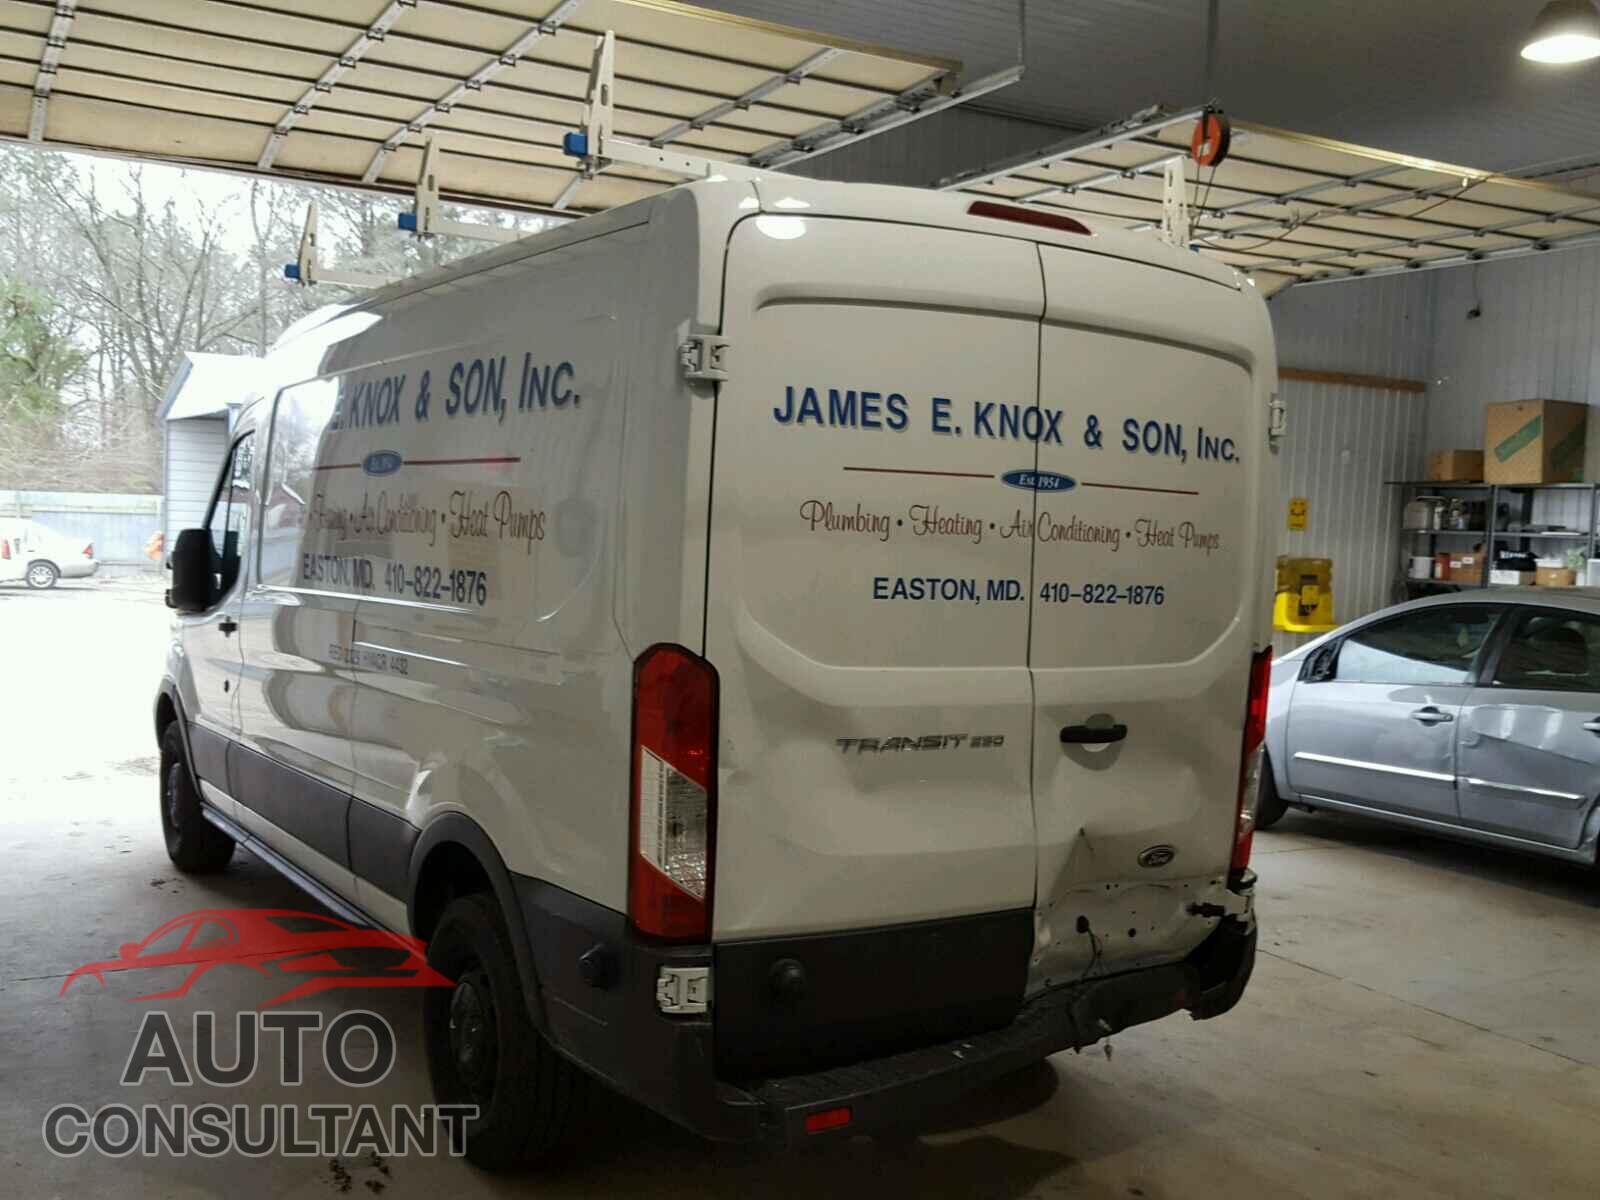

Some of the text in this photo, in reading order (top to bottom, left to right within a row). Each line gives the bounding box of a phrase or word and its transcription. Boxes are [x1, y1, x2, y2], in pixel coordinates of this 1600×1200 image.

[350, 374, 406, 428] KNOX
[415, 369, 431, 421] &
[446, 356, 507, 425] SON,
[773, 386, 909, 431] JAMES
[932, 397, 961, 436] E.
[974, 401, 1063, 444] KNOX
[1084, 414, 1102, 449] &
[1122, 418, 1187, 463] SON,
[450, 490, 488, 540] Heat
[495, 490, 545, 555] Pumps
[800, 500, 891, 542] Plumbing
[908, 504, 983, 545] Heating
[1037, 511, 1120, 552] Conditioning
[1134, 518, 1175, 548] Heat
[1178, 521, 1220, 556] Pumps
[384, 562, 487, 606] 410-822-1876
[873, 577, 1164, 606] EASTON, MD. 410-822-1876
[836, 734, 968, 754] TRANSIT
